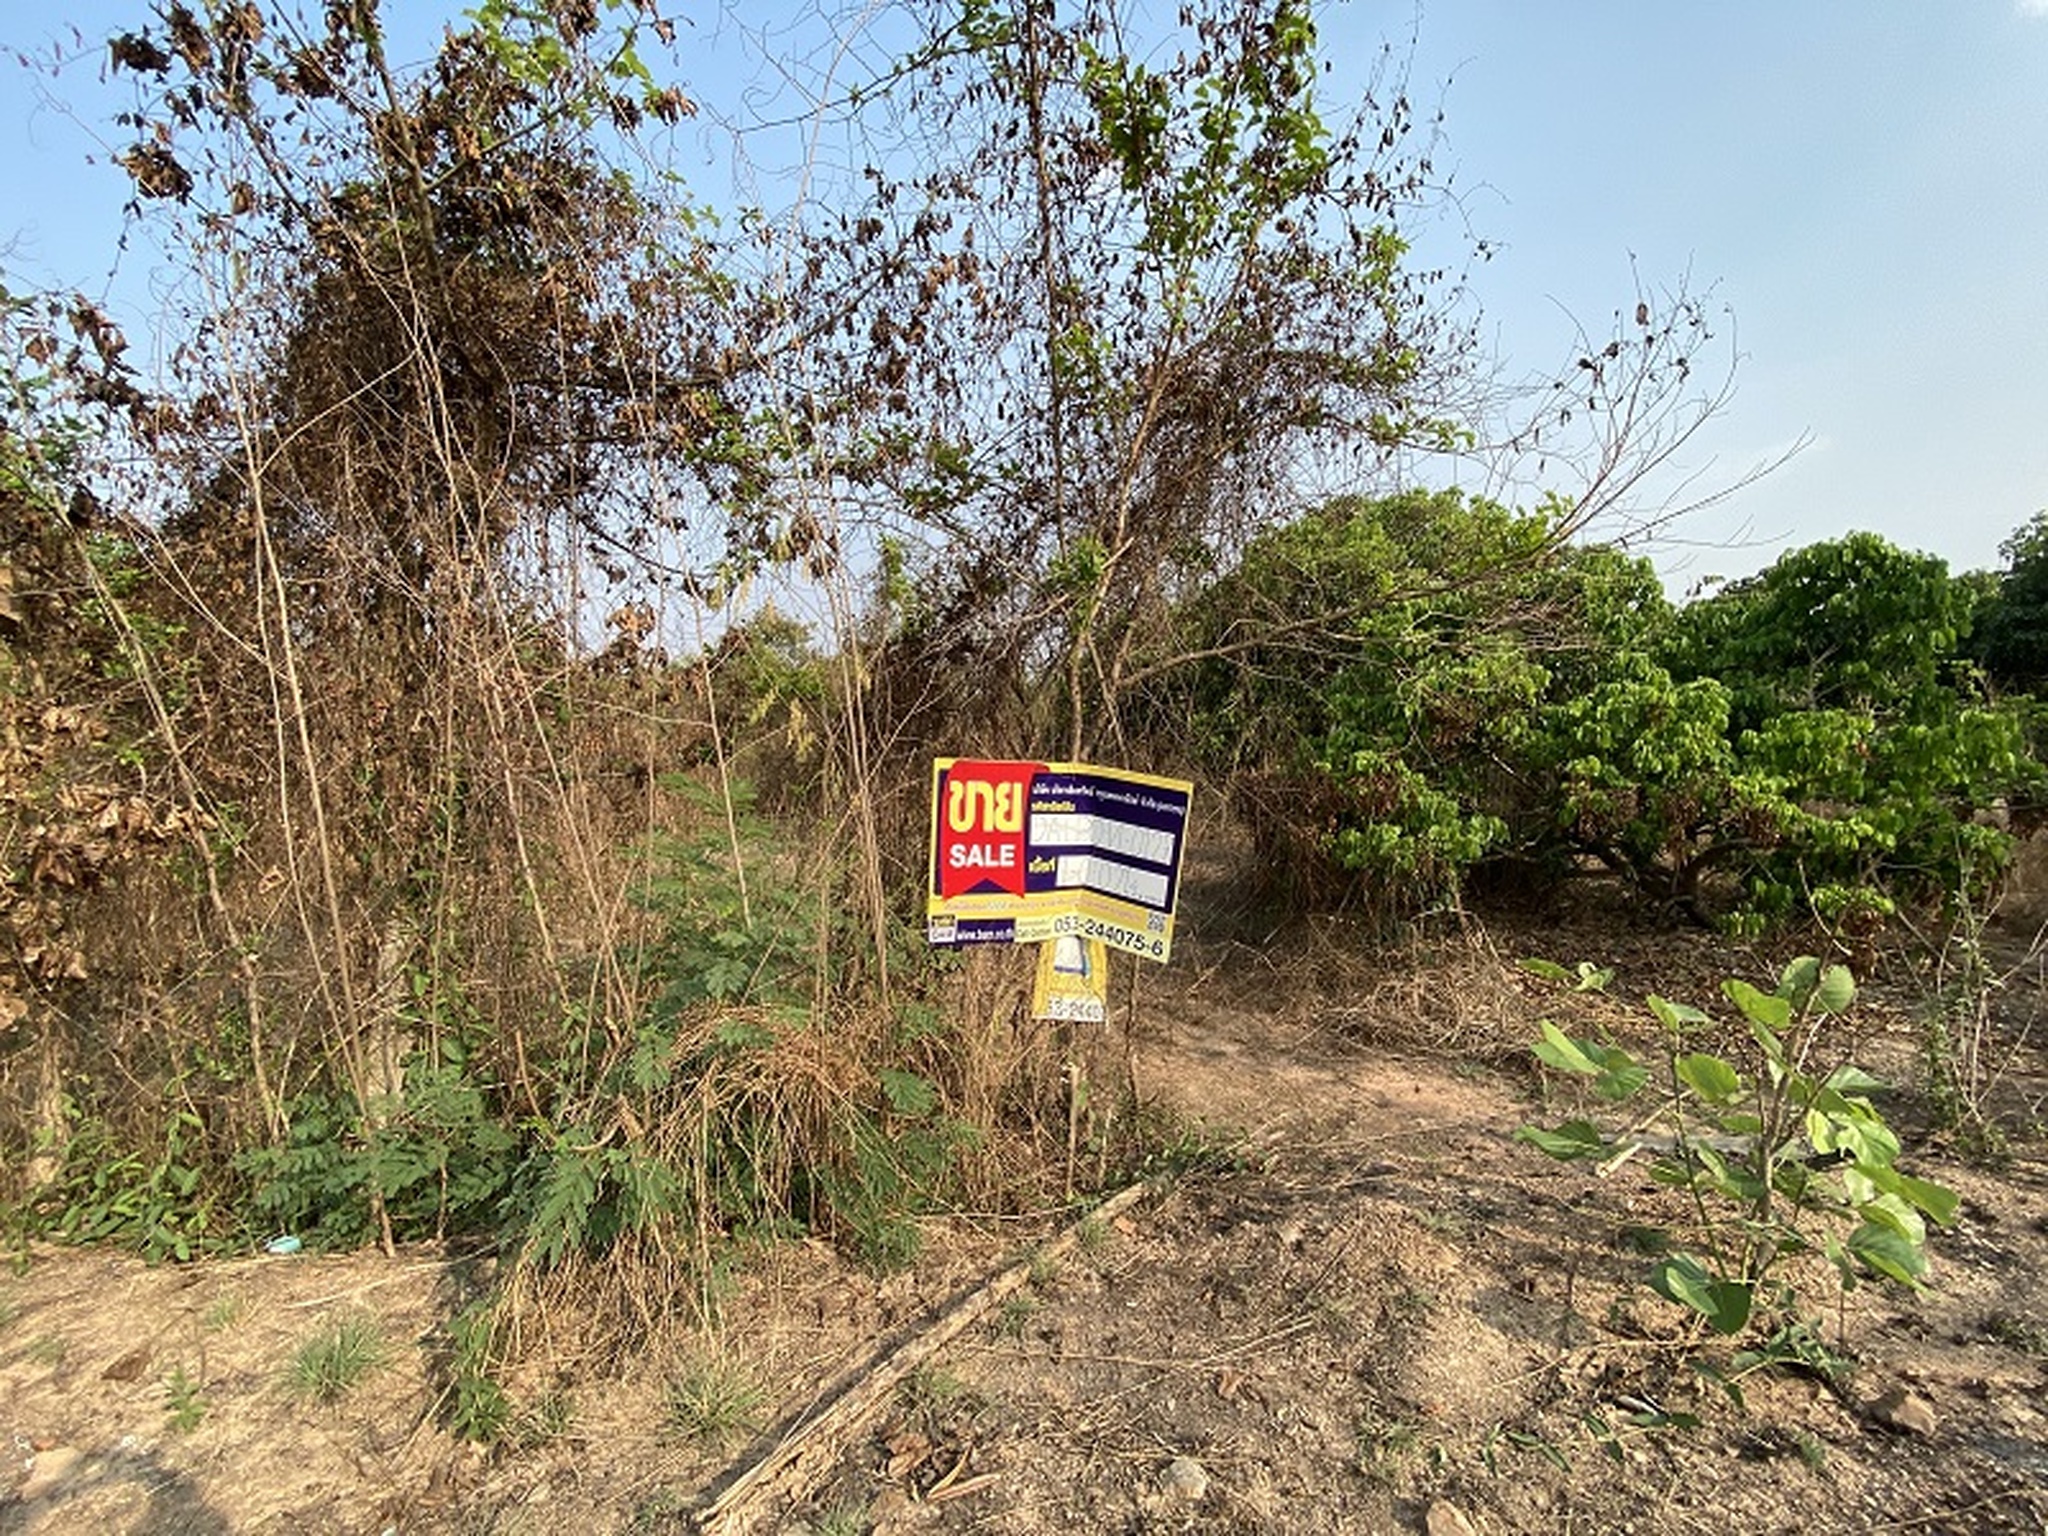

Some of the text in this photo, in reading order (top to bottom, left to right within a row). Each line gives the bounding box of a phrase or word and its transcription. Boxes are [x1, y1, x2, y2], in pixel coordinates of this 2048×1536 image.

[949, 780, 1022, 833] ขาย
[950, 844, 1015, 867] SALE
[1054, 914, 1164, 957] 053-244075-6
